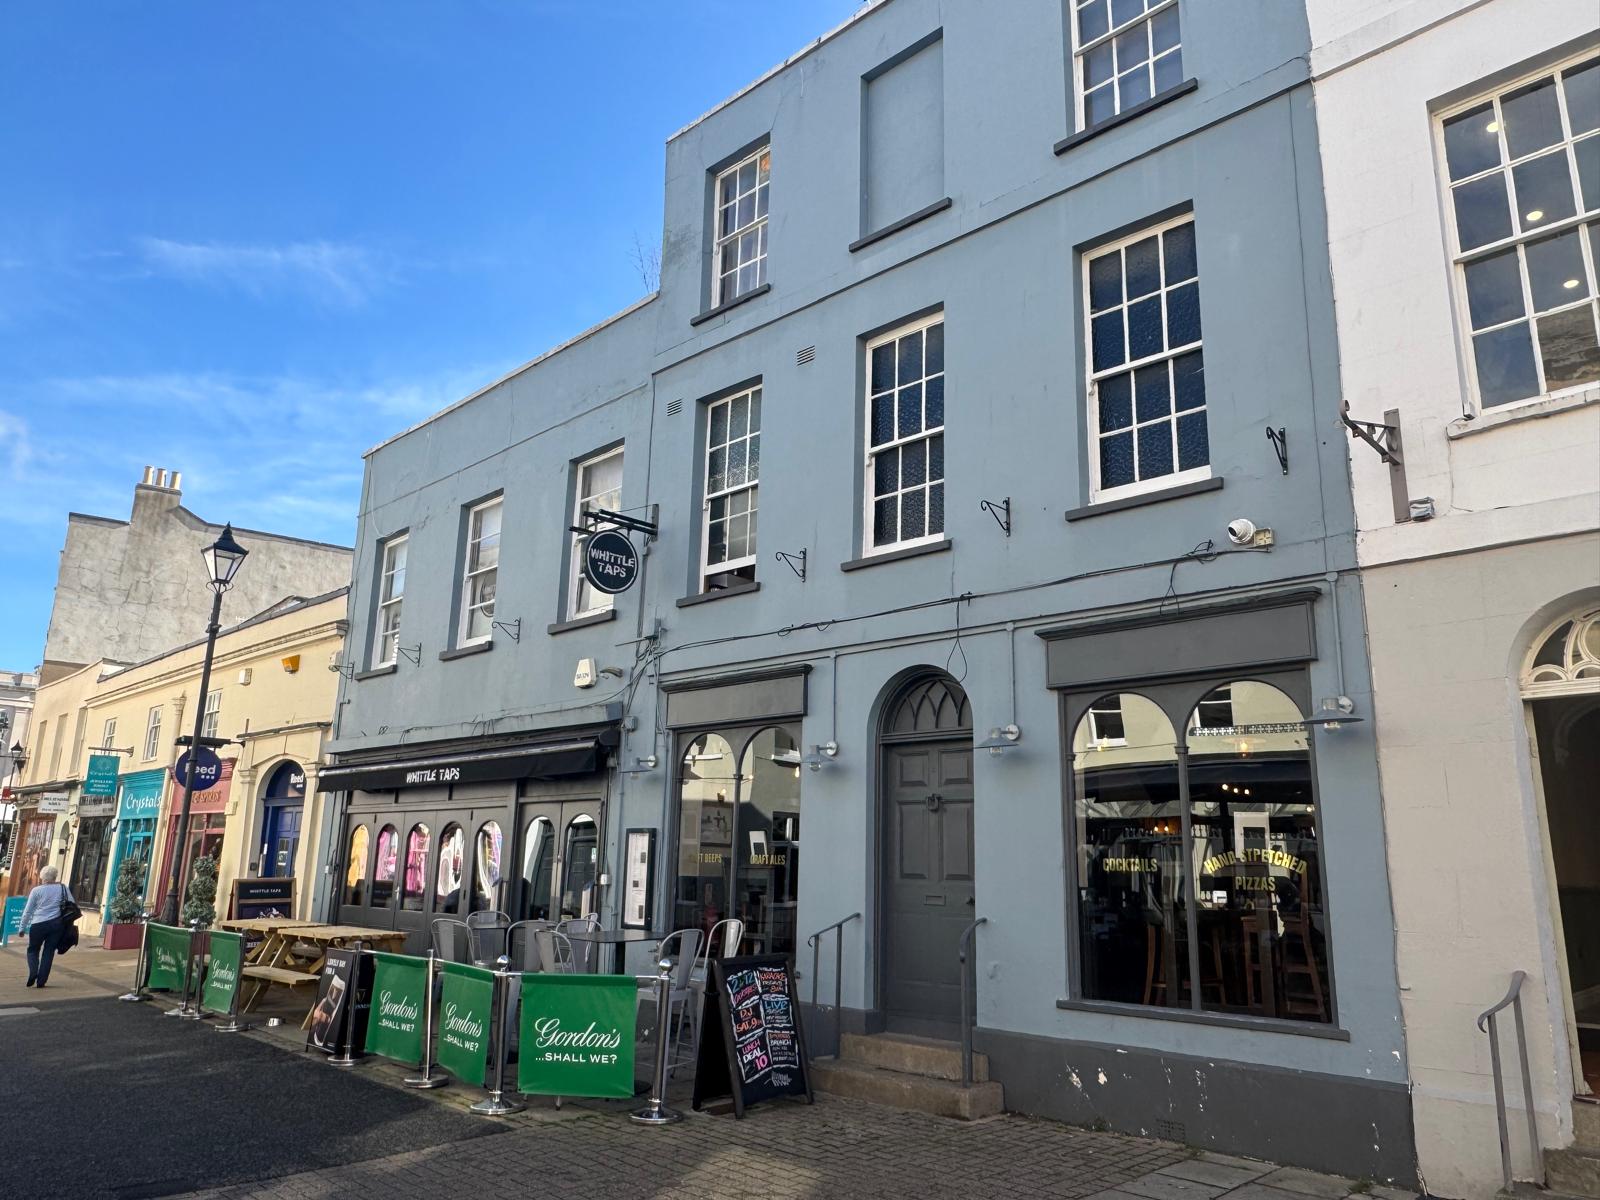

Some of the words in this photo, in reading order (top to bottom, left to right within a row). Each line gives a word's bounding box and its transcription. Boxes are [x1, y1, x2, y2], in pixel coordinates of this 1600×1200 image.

[591, 548, 635, 568] WHITTLE
[598, 562, 627, 578] TAPS
[406, 769, 437, 783] WHITTLE
[439, 767, 460, 781] TAPS
[126, 792, 161, 814] Crystals
[769, 854, 786, 865] ALES
[1103, 857, 1158, 872] COCKTAILS
[1204, 850, 1236, 874] HAND
[1236, 876, 1276, 891] PIZZAS
[380, 990, 418, 1020] Gordon's
[764, 1001, 788, 1009] LIVE
[401, 1023, 415, 1032] WE?
[445, 1002, 482, 1038] Gordon's
[535, 1017, 622, 1048] Gordon's
[464, 1040, 479, 1052] WE?
[741, 1039, 761, 1054] LUNCH
[590, 1053, 617, 1063] WE?
[743, 1047, 767, 1064] DEAL
[755, 1054, 769, 1071] 10
